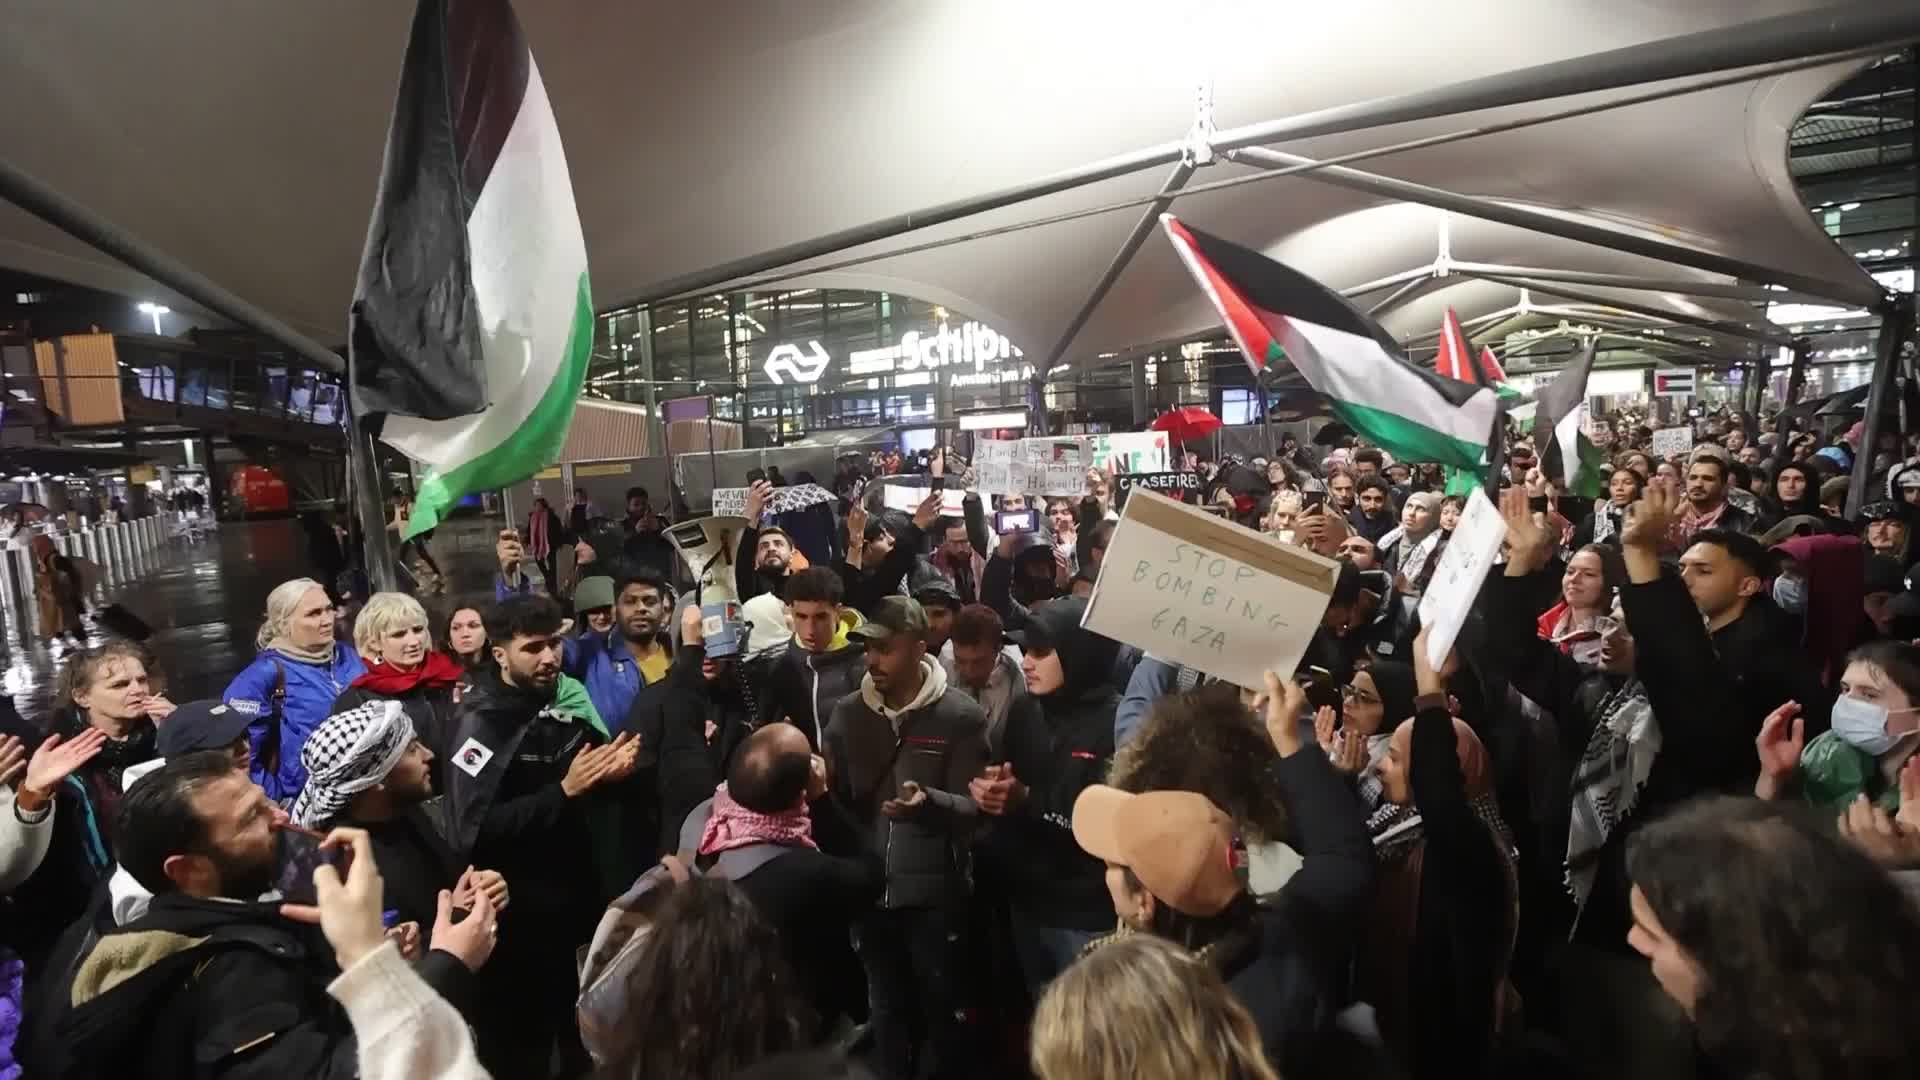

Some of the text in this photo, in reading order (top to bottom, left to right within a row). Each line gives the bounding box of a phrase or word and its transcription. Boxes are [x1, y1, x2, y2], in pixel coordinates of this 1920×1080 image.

[1167, 544, 1256, 583] STOP
[1132, 560, 1289, 629] BOMBING
[1151, 607, 1226, 653] GAZA
